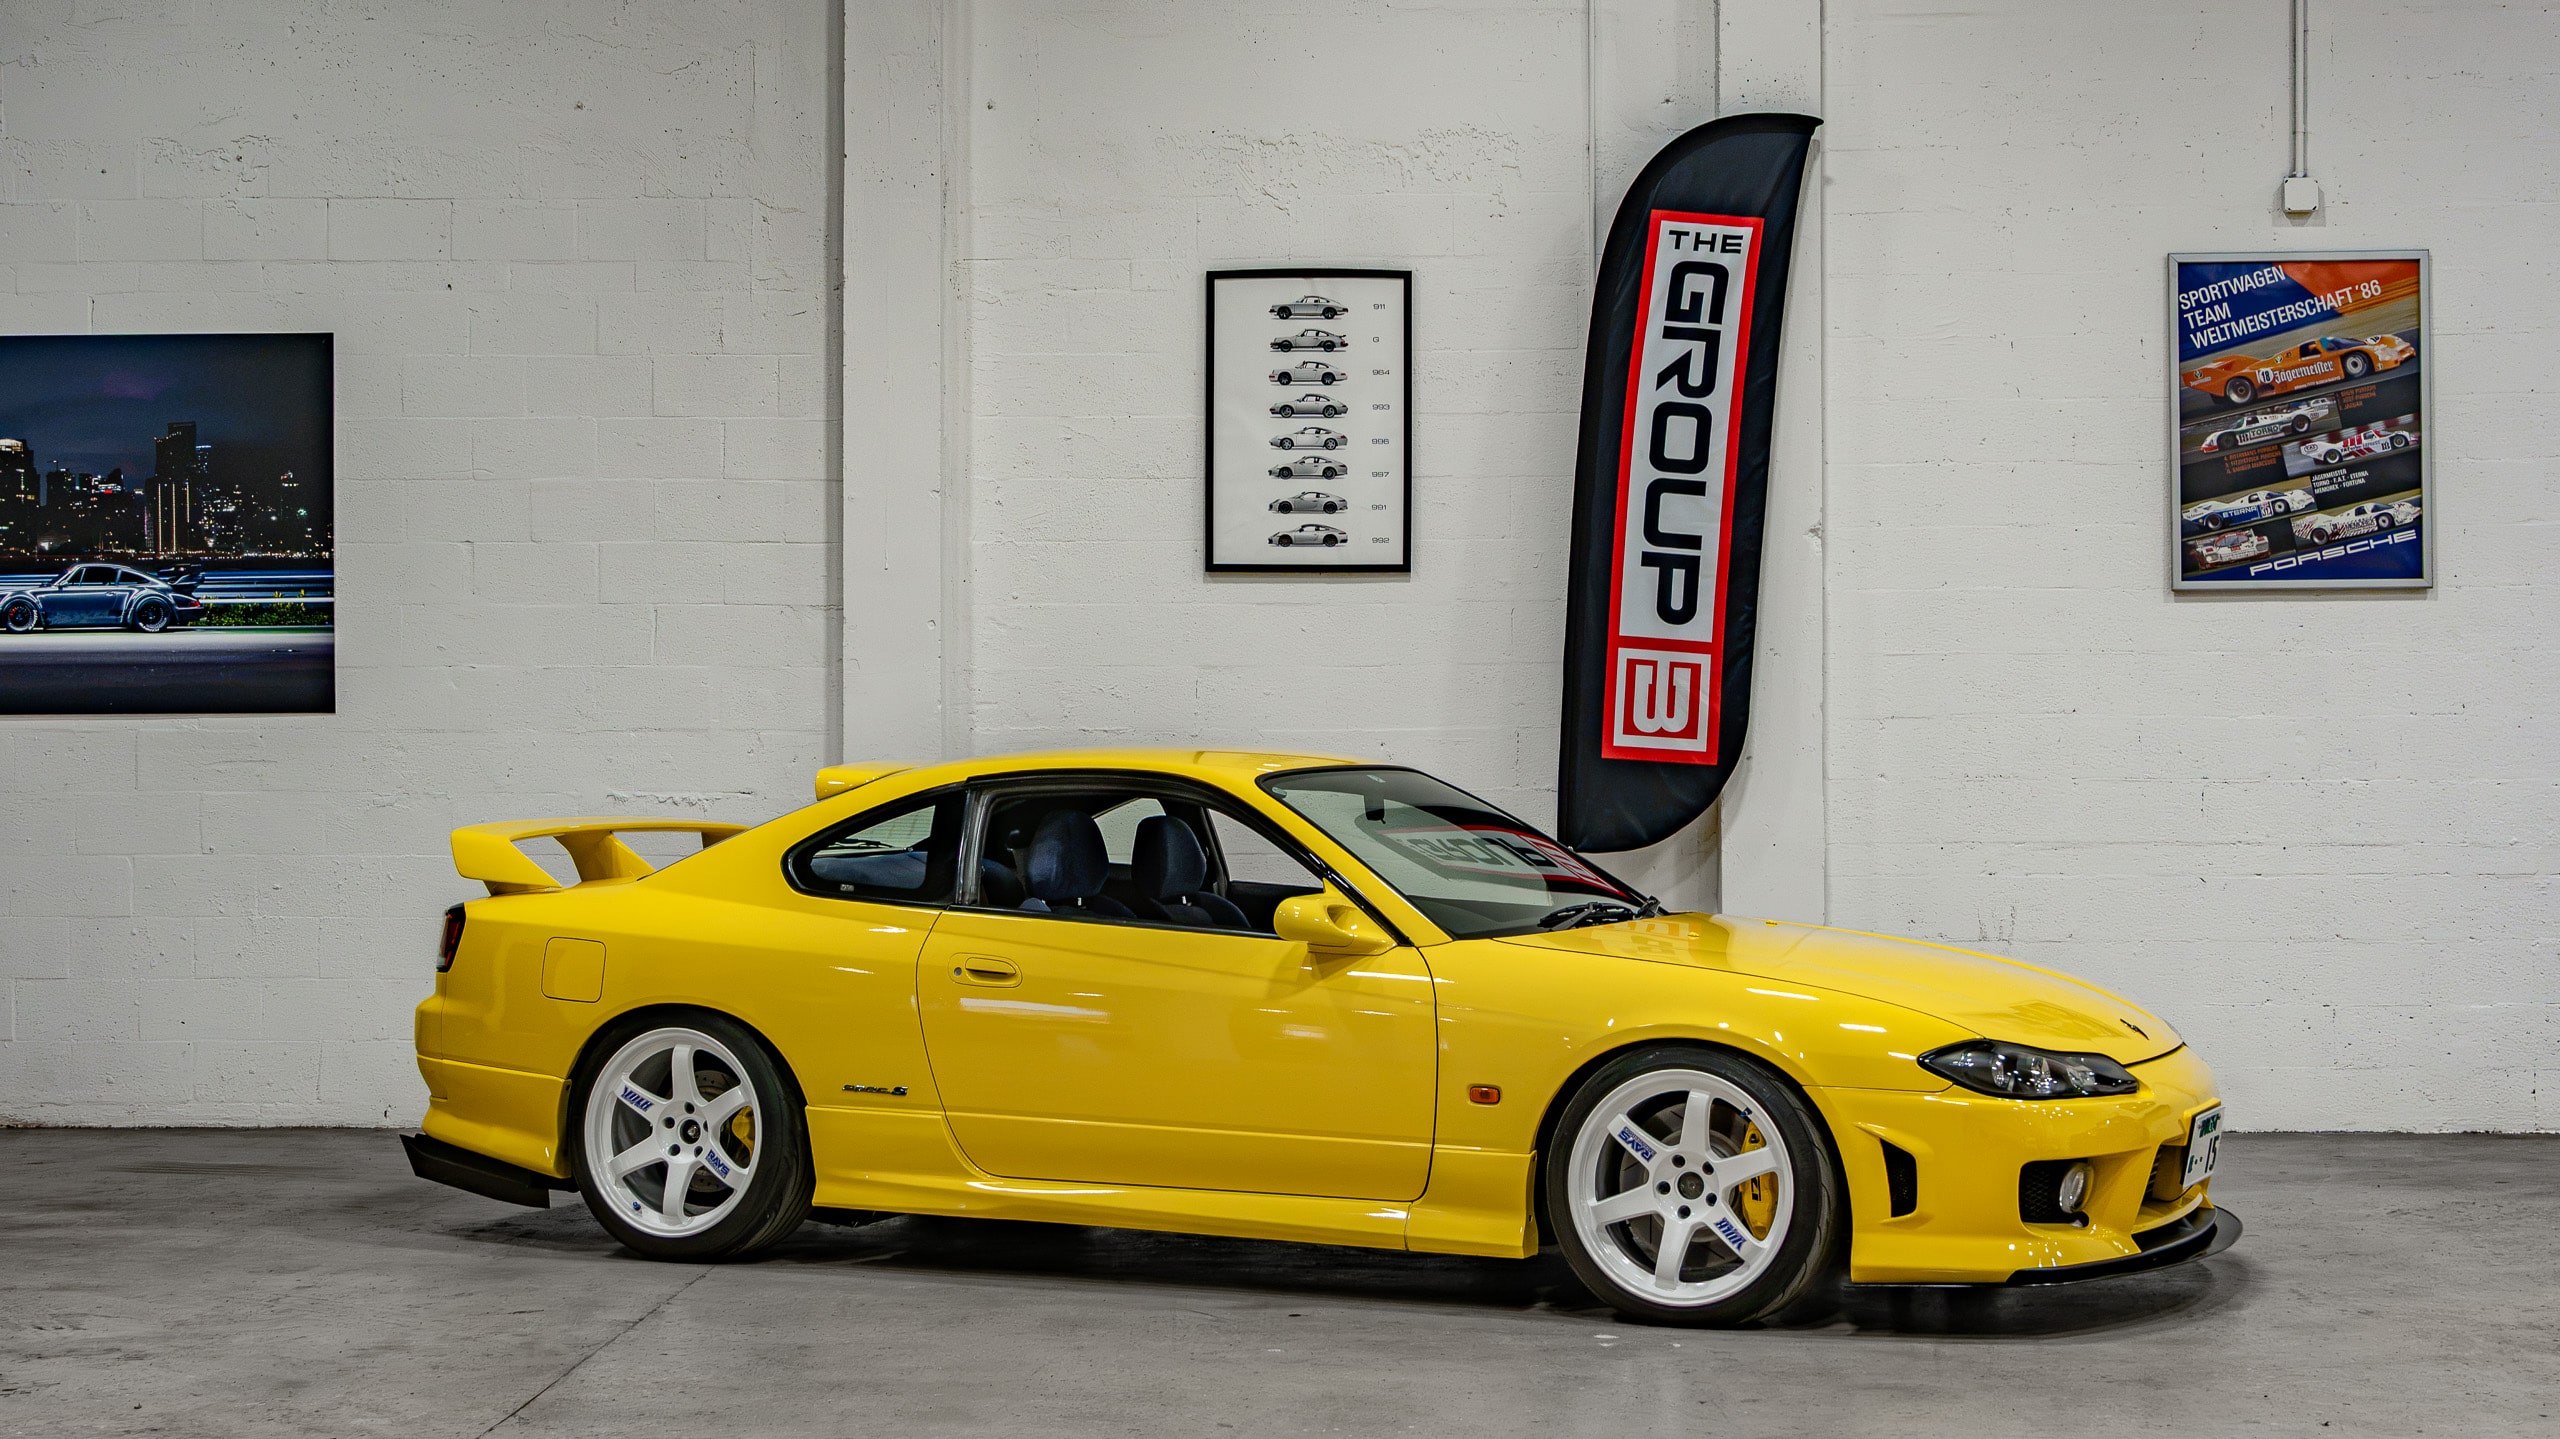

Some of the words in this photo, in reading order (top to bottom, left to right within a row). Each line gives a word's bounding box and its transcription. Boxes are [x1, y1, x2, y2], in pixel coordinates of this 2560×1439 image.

[1668, 229, 1744, 255] THE
[2179, 265, 2287, 310] SPORTWAGEN
[1372, 303, 1386, 311] 911
[2184, 302, 2232, 330] TEAM
[2190, 287, 2354, 349] WELTMEISTERSCHAFT
[1371, 403, 1391, 411] 993
[1640, 260, 1730, 627] GROUP
[1371, 503, 1387, 511] 991
[2222, 505, 2257, 519] ETERNA
[1371, 536, 1390, 544] 992
[2250, 529, 2417, 577] PORSCHE
[706, 1149, 731, 1176] RAYS
